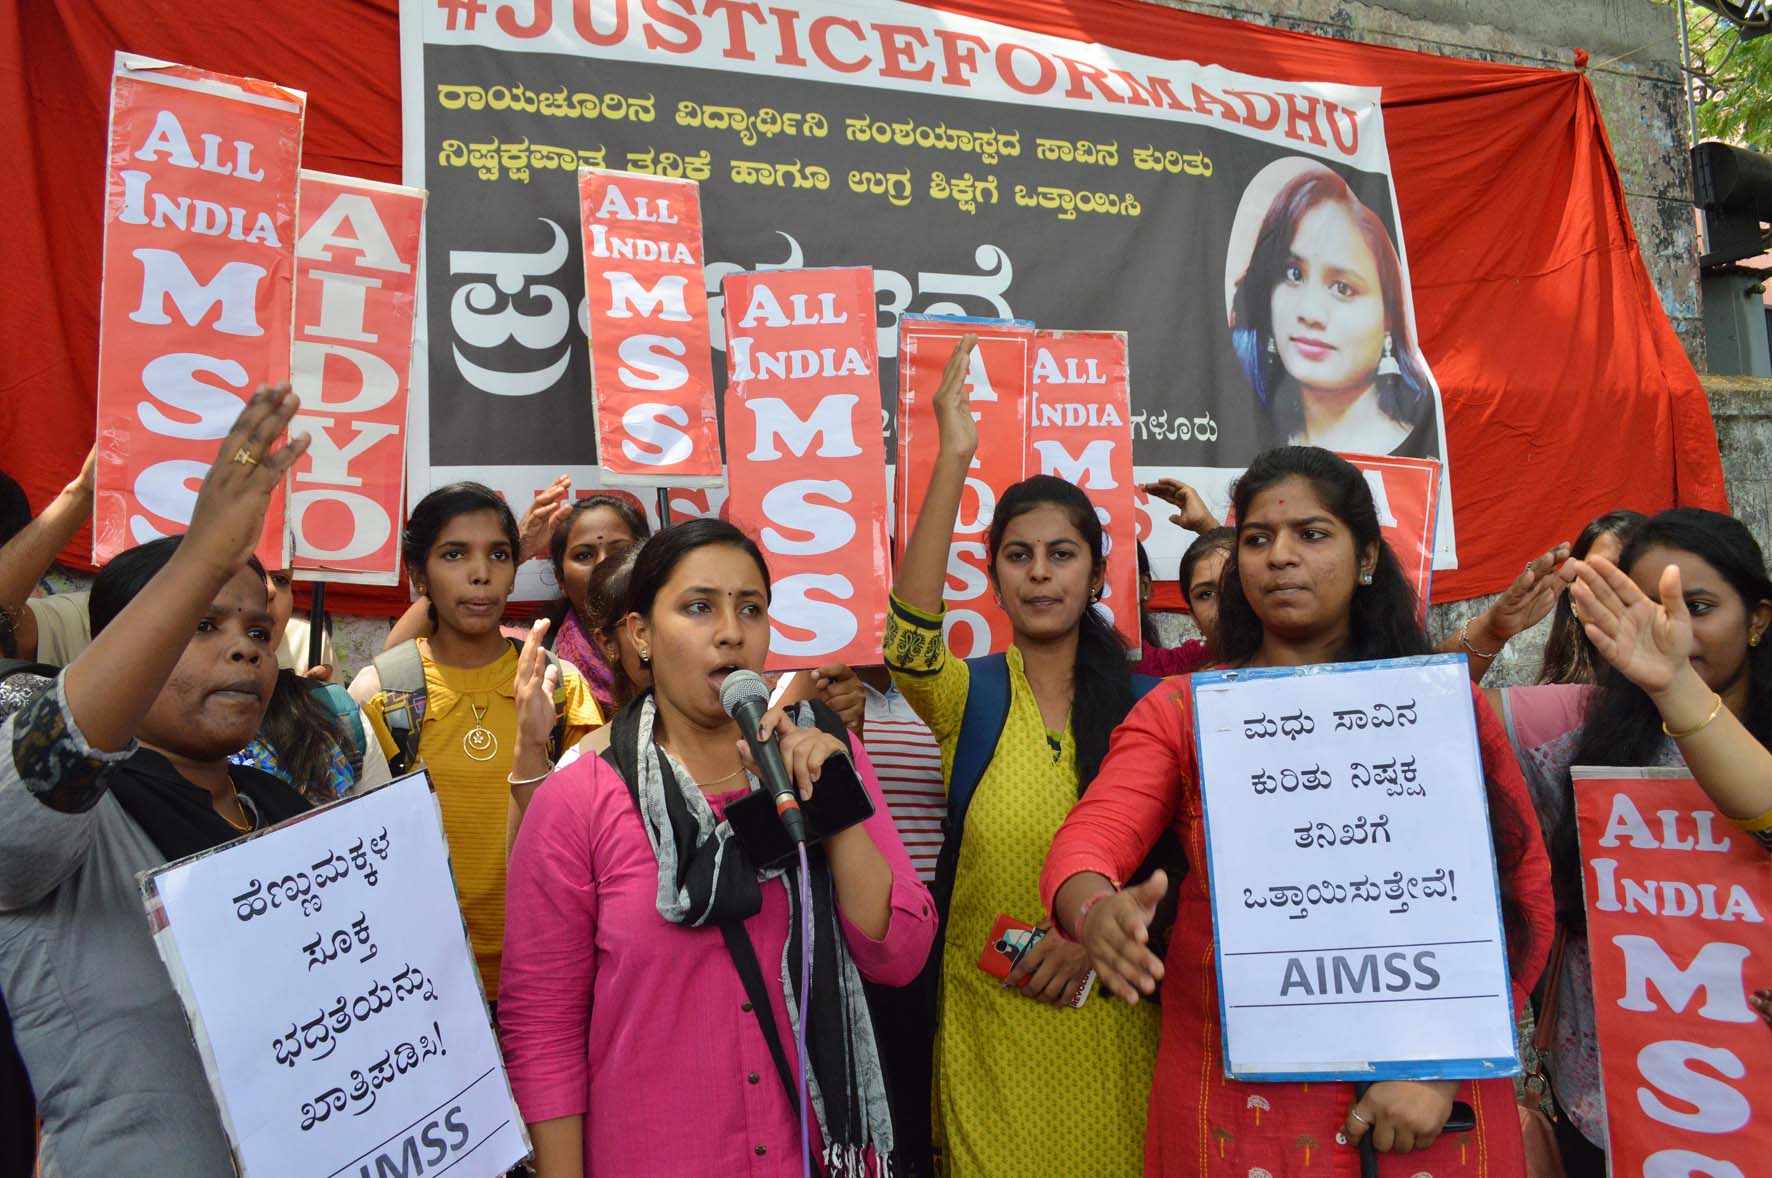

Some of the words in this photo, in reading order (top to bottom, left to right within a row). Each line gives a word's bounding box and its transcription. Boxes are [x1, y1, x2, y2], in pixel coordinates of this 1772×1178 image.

[134, 110, 265, 183] ALL
[438, 80, 656, 122] ರಾಯಚೂರಿನ
[675, 100, 829, 146] ವಿದ್ಯಾರ್ಥಿನಿ
[845, 113, 1021, 165] ಸಂಶಯಾಸ್ಪದ
[1035, 138, 1119, 167] ಸಾವಿನ
[1132, 144, 1213, 177] ಕುರಿತು
[119, 170, 281, 247] INDIA
[596, 184, 678, 224] ALL
[626, 145, 711, 180] ತನಿಕೆ
[730, 157, 831, 190] ಹಾಗೂ
[848, 167, 912, 206] ಉಗ್ರ
[929, 170, 999, 215] ಶಿಕ್ಷೆಗೆ
[1013, 184, 1142, 220] ಒತ್ತಾಯಿಸಿ
[589, 223, 696, 265] INDIA
[738, 284, 848, 328] ALL
[729, 336, 870, 382] INDIA
[1243, 702, 1315, 741] ಮಧು
[1332, 697, 1418, 733] ಸಾವಿನ
[1251, 763, 1332, 795] ಕುರಿತು
[1350, 755, 1427, 797] ನಿಷ್ಪಕ್ಷ
[1293, 814, 1392, 849] ತನಿಖೆಗೆ
[1598, 792, 1731, 853] ALL
[232, 825, 390, 922] ಹೆಣ್ಣುಮಕ್ಕಳ
[1243, 868, 1458, 920] ಒತ್ತಾಯಿಸುತ್ತೇವೆ!
[1589, 857, 1765, 923] INDIA
[302, 910, 378, 973] ಸೂಕ್ತ
[1279, 950, 1442, 998] AIMSS
[272, 962, 439, 1068] ಭದ್ರತೆಯನ್ನು
[300, 1021, 447, 1132] ಖಾತ್ರಿಪಡಿಸಿ!
